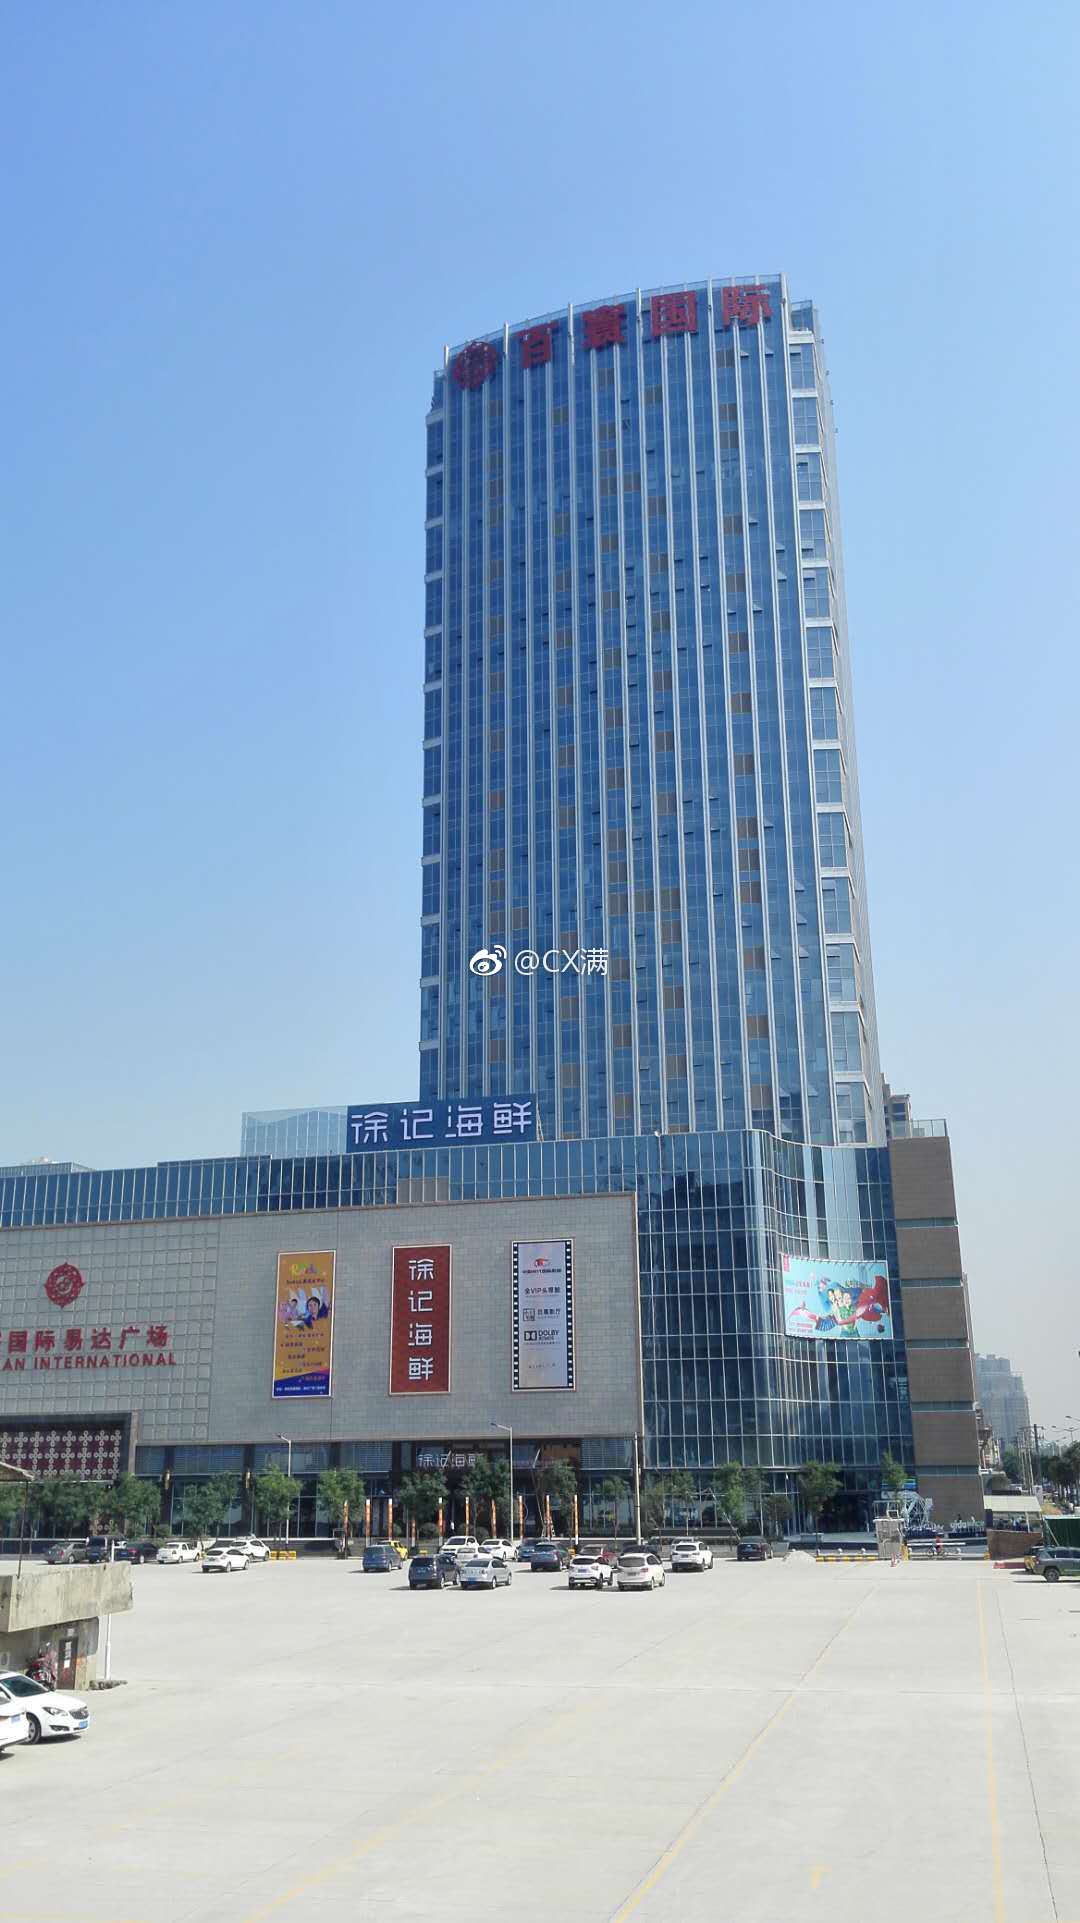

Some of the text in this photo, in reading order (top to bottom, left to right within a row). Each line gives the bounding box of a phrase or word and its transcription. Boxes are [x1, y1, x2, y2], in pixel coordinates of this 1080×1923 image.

[351, 1101, 532, 1145] 徐记海鲜
[408, 1258, 434, 1381] 徐记海鲜
[0, 1325, 170, 1354] 国际易达广场
[34, 1352, 177, 1370] INTERNATIONAL
